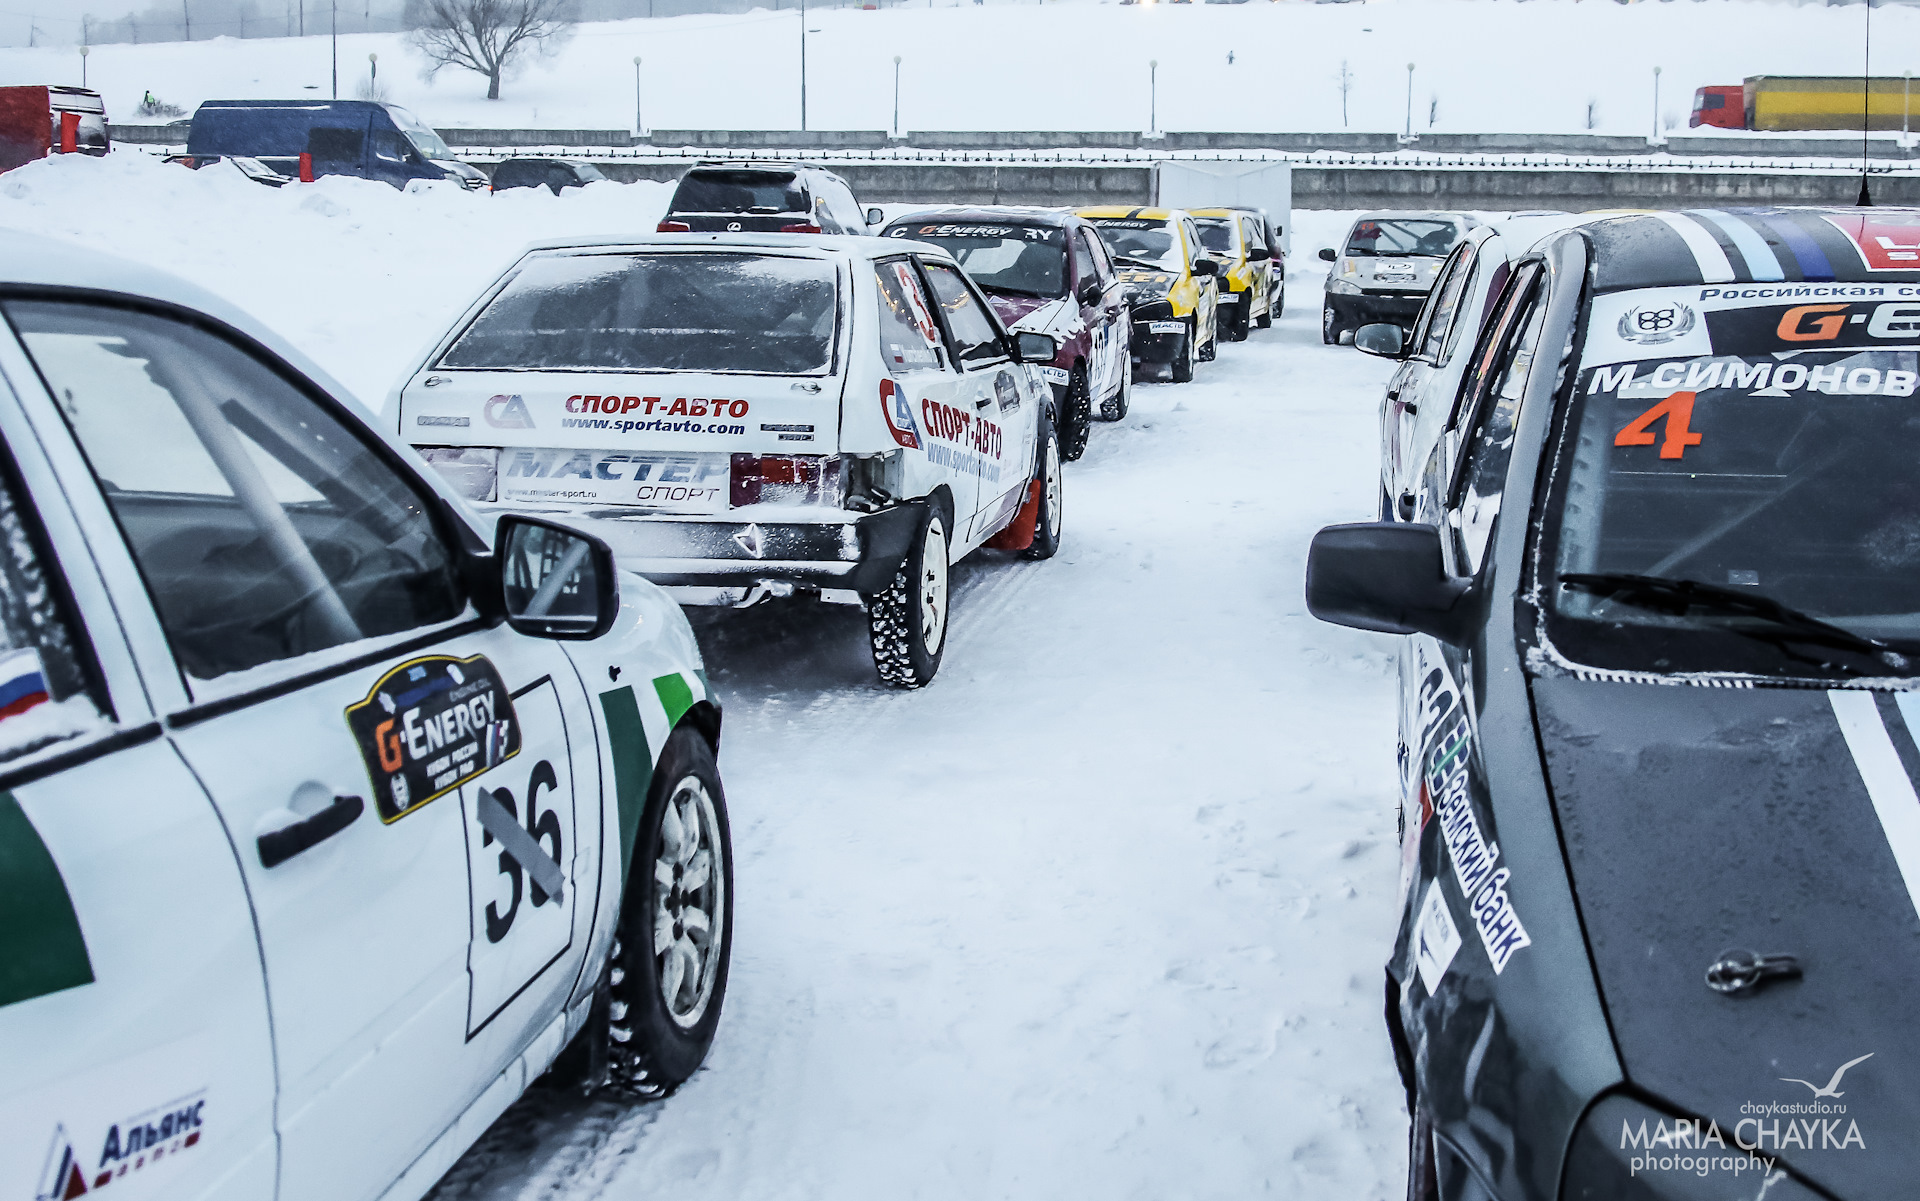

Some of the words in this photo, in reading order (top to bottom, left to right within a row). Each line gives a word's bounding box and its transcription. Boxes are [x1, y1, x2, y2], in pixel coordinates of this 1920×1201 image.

[1699, 284, 1884, 301] Российская
[1587, 361, 1917, 397] М.СИМОНОВ
[565, 394, 750, 418] СПОРТ-АВТО
[561, 418, 746, 435] www.sportavto.com
[922, 398, 1002, 461] СПОРТ-АВТО
[1614, 390, 1703, 460] 4
[506, 452, 729, 483] МАСТЕР
[506, 487, 598, 499] www.mster-sport.ru
[637, 485, 721, 501] СПОРТ
[1438, 774, 1495, 891] Земский
[1474, 873, 1522, 964] банк
